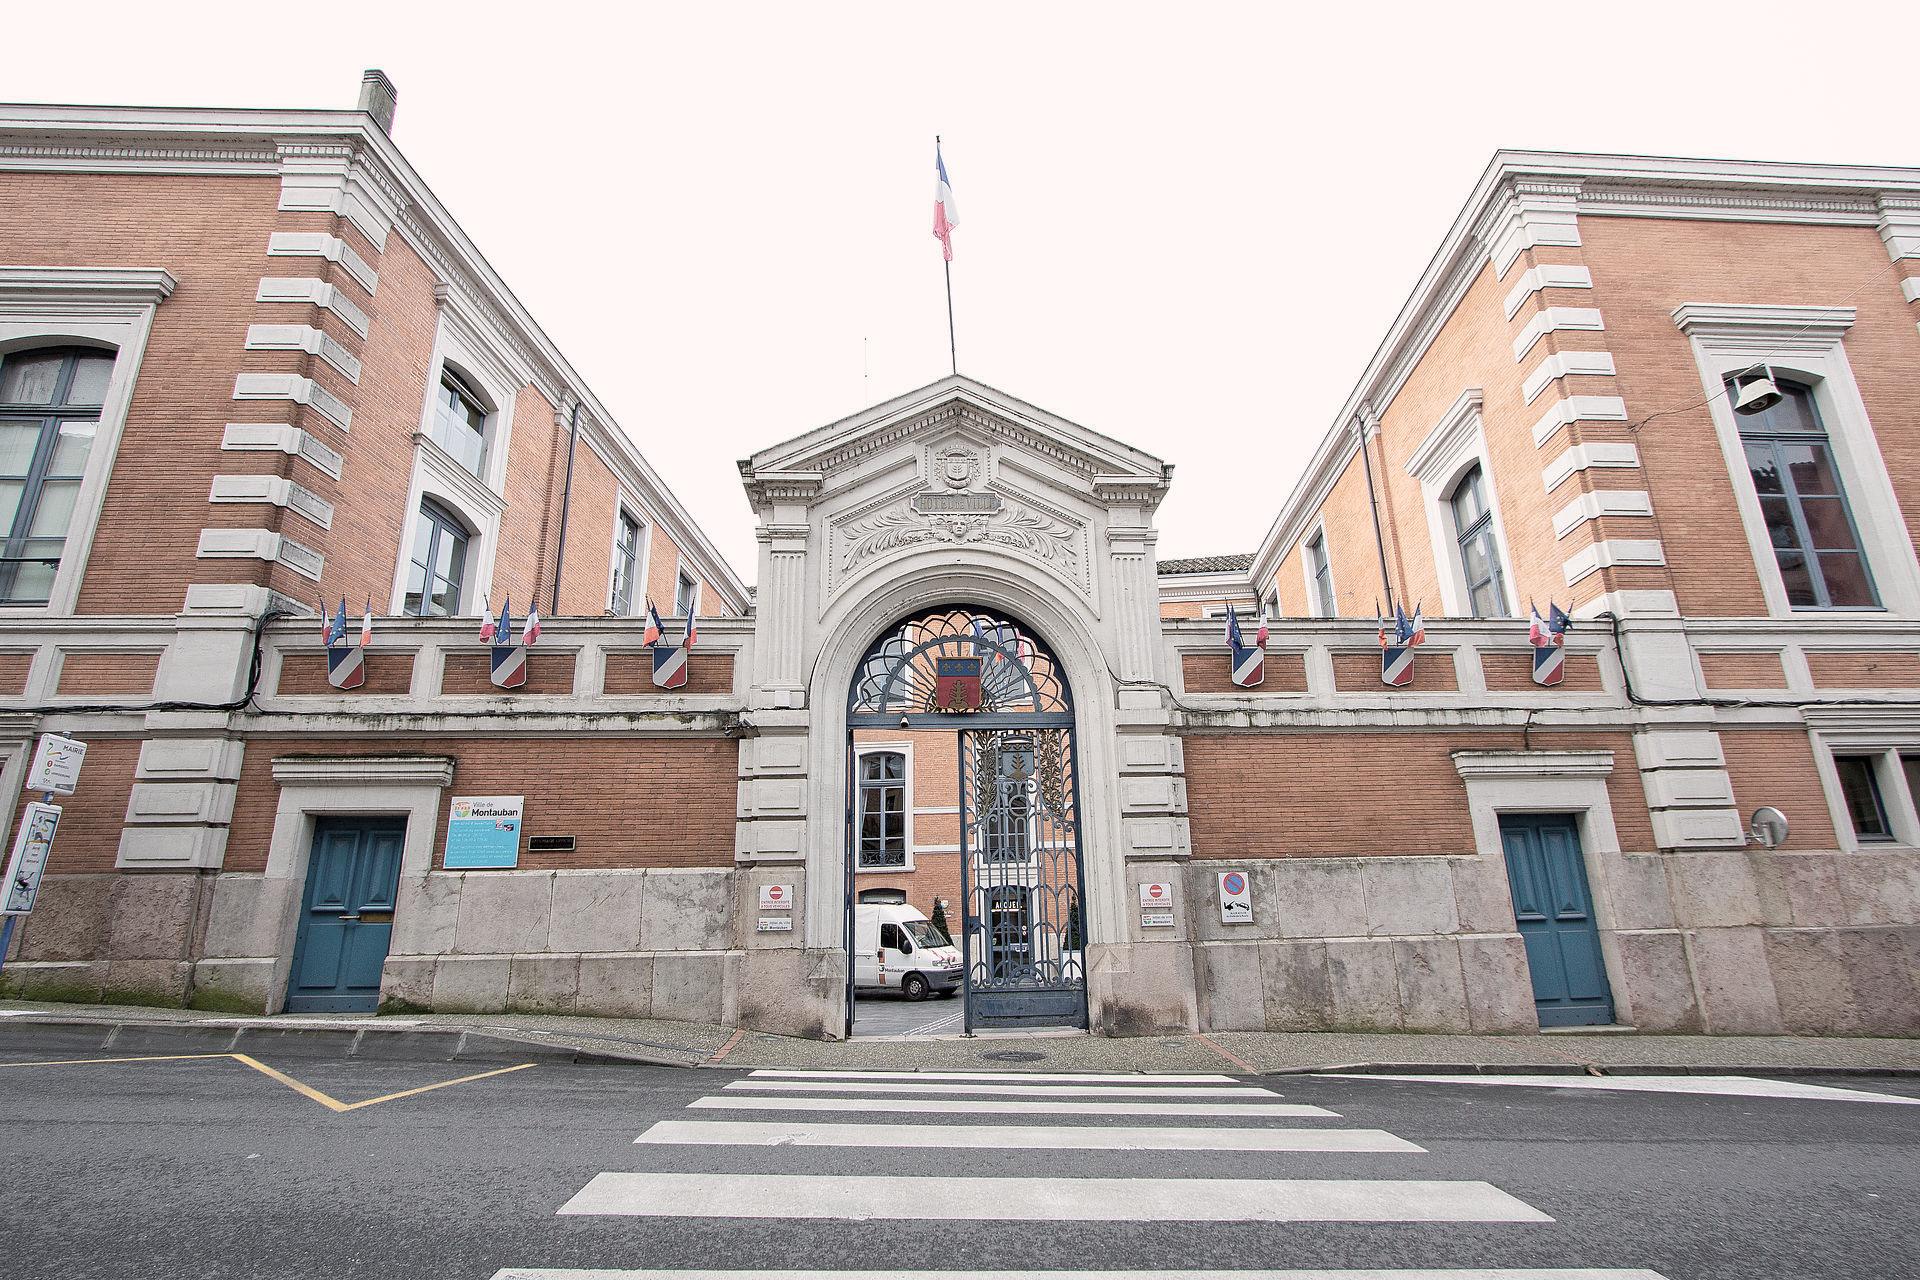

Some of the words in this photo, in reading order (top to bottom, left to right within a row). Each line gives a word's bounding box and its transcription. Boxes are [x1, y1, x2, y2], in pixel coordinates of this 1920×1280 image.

[966, 497, 995, 510] VILLE
[63, 745, 84, 755] MAIRIE
[471, 808, 518, 817] Montauban
